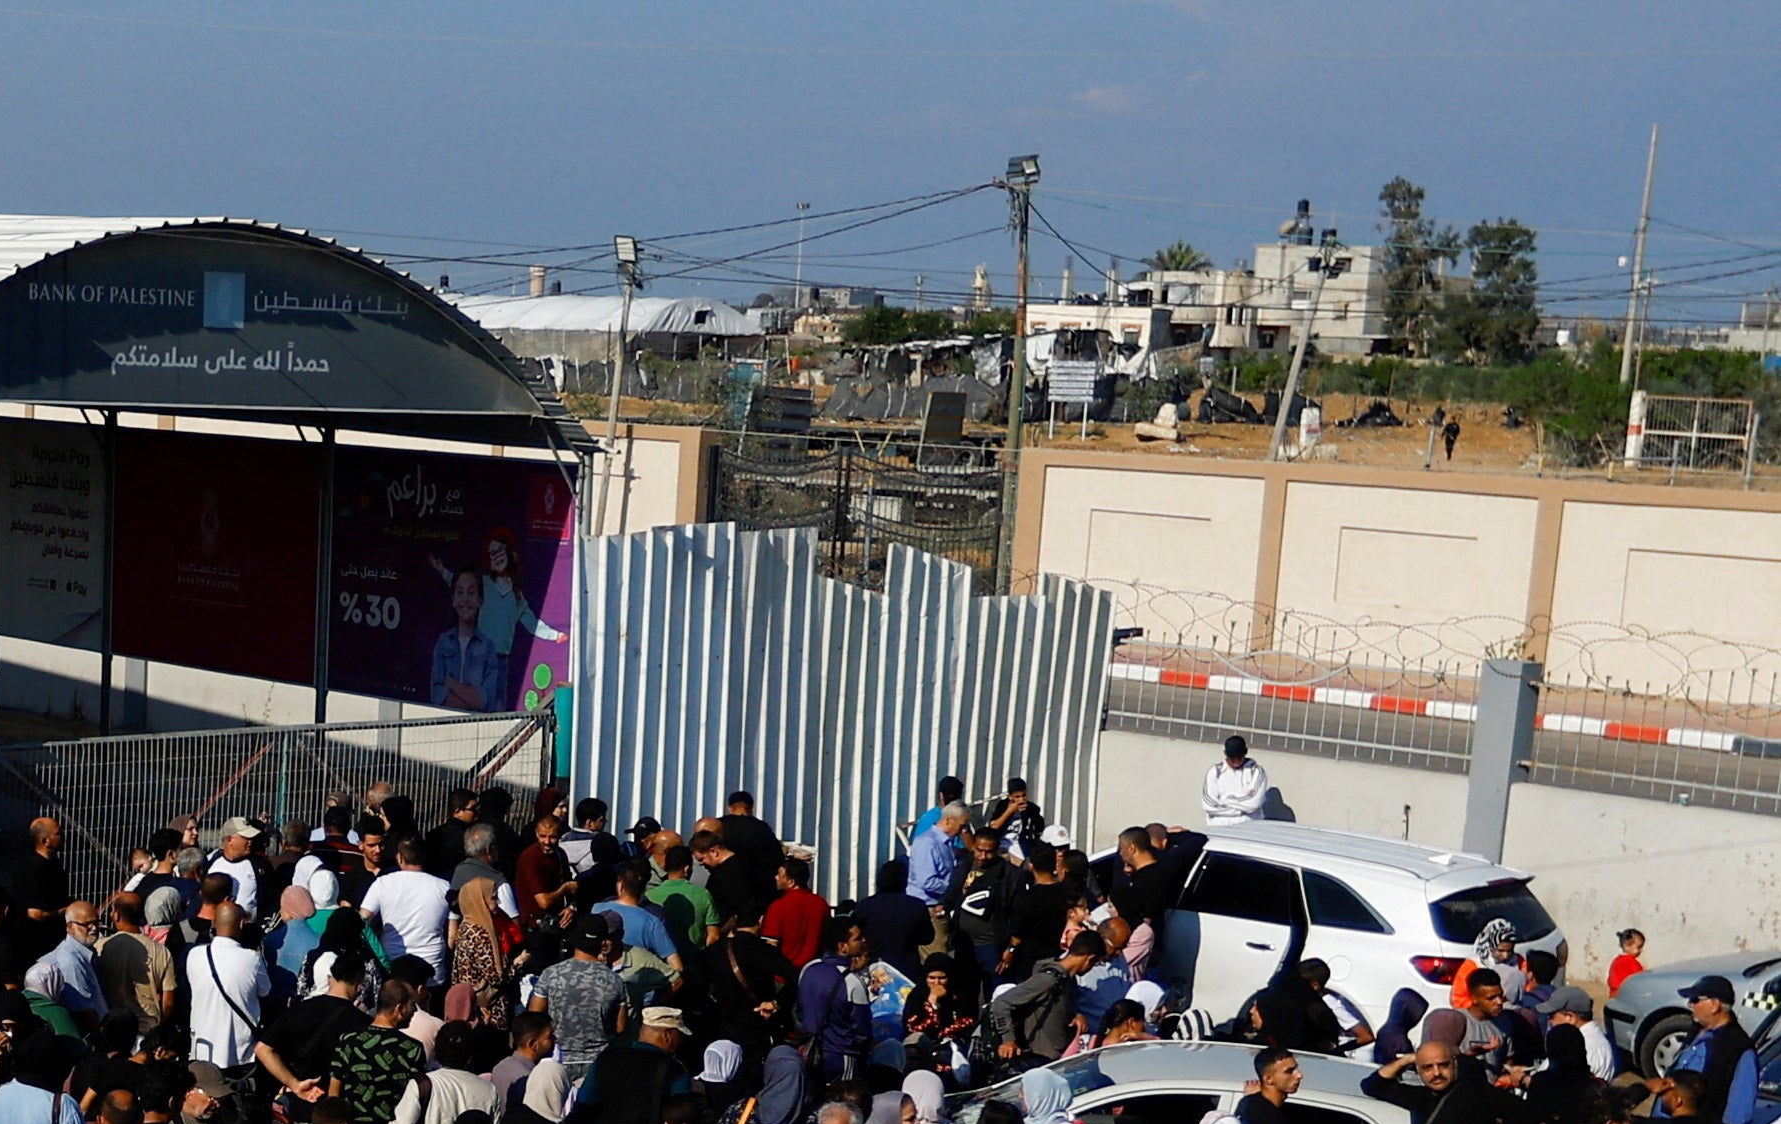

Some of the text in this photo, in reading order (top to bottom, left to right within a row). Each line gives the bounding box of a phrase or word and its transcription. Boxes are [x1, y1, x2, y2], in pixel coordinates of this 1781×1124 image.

[28, 282, 196, 307] BANK OF PALESTINE
[253, 290, 409, 320] بنك فلسطين
[110, 343, 198, 376] سلامتكم
[204, 348, 247, 374] على
[252, 349, 281, 372] لله
[386, 463, 437, 518] براعم
